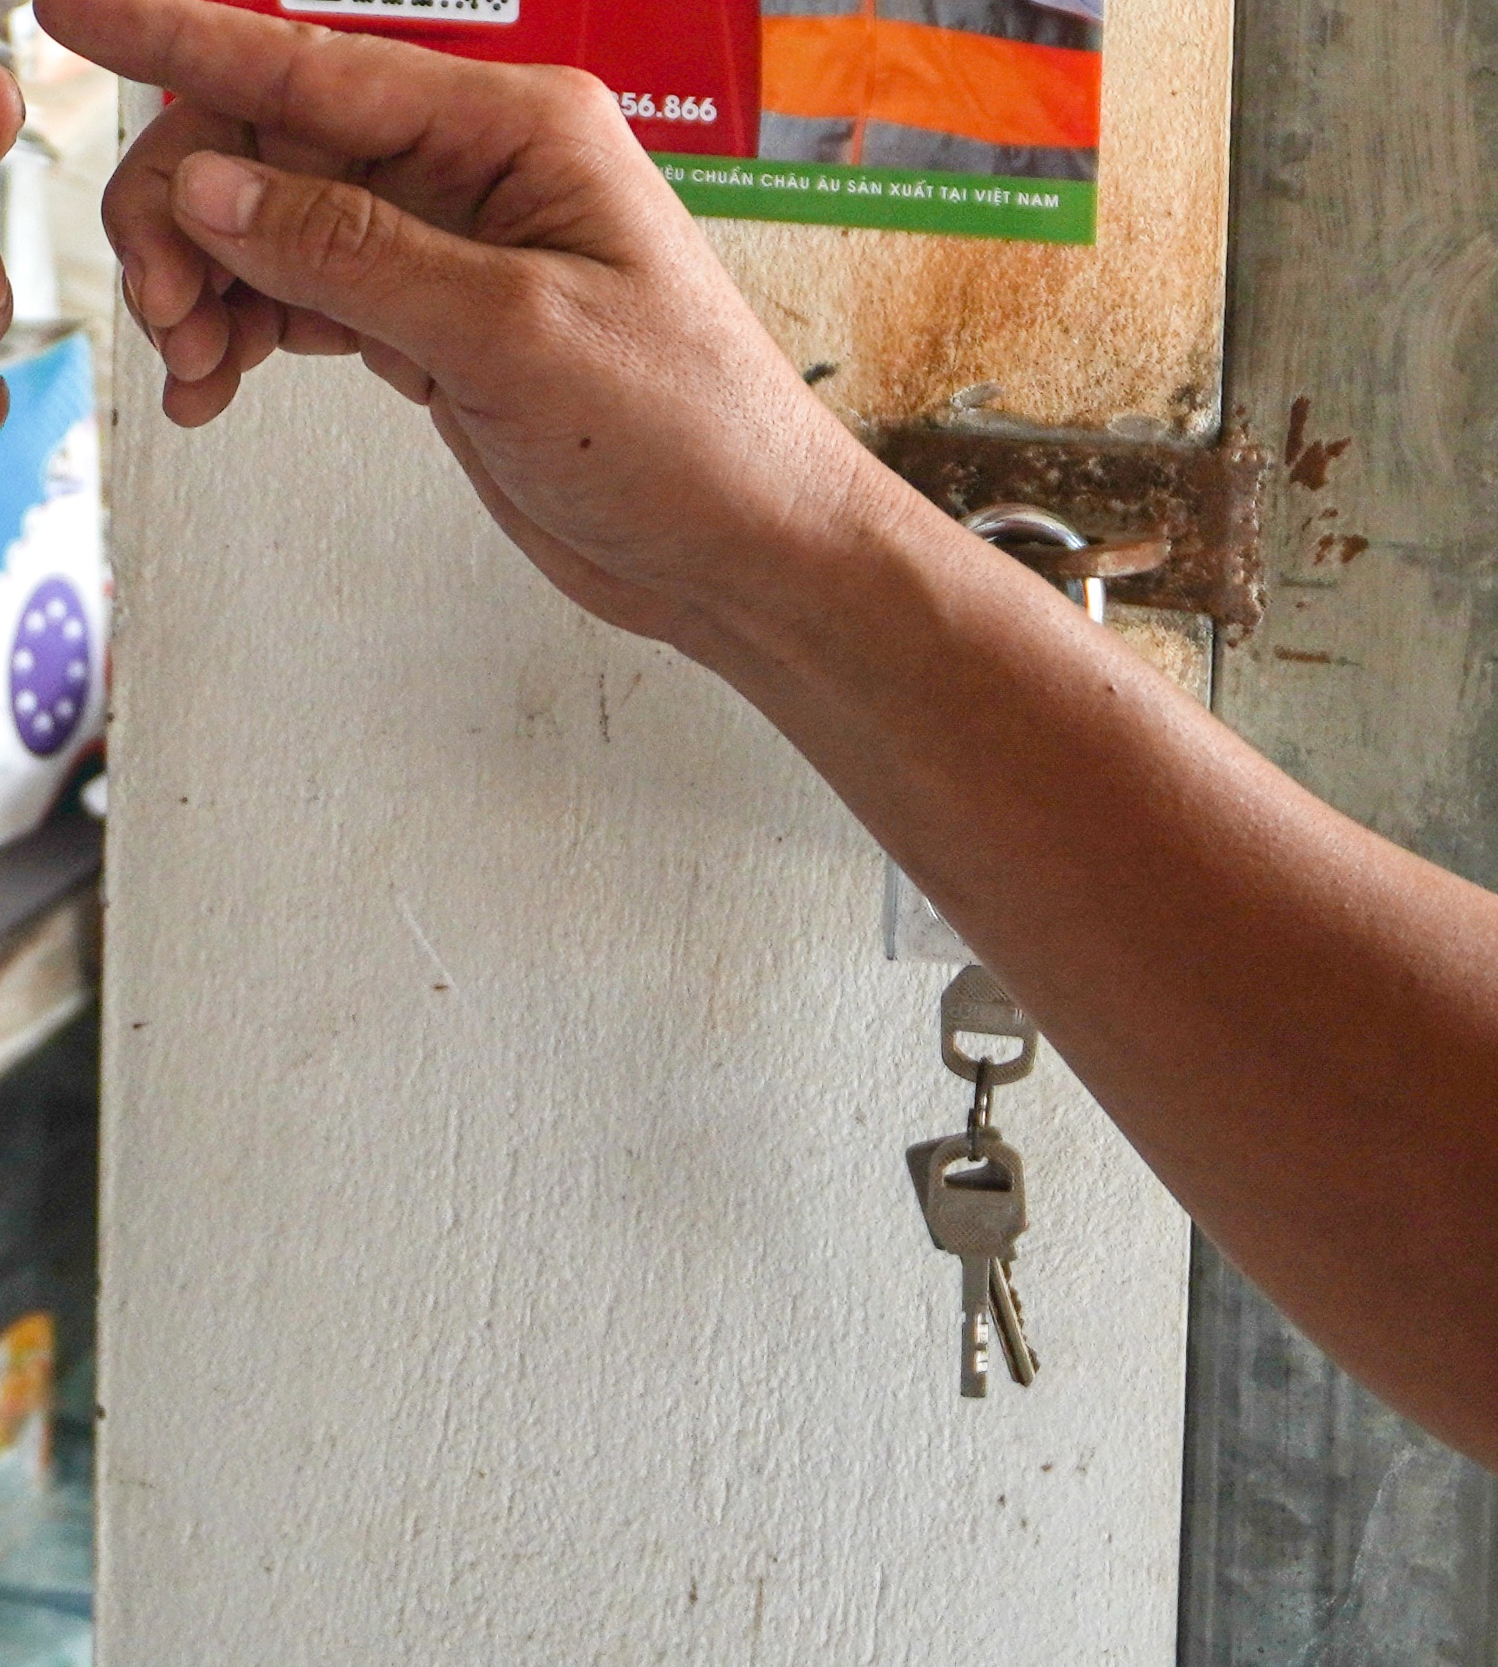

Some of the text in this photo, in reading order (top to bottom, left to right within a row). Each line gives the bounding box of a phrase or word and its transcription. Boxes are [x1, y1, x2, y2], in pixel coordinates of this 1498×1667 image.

[692, 166, 1059, 208] CHUẨN CHÂU ÂU SẢN XUẤT TẠI VIỆT NAM
